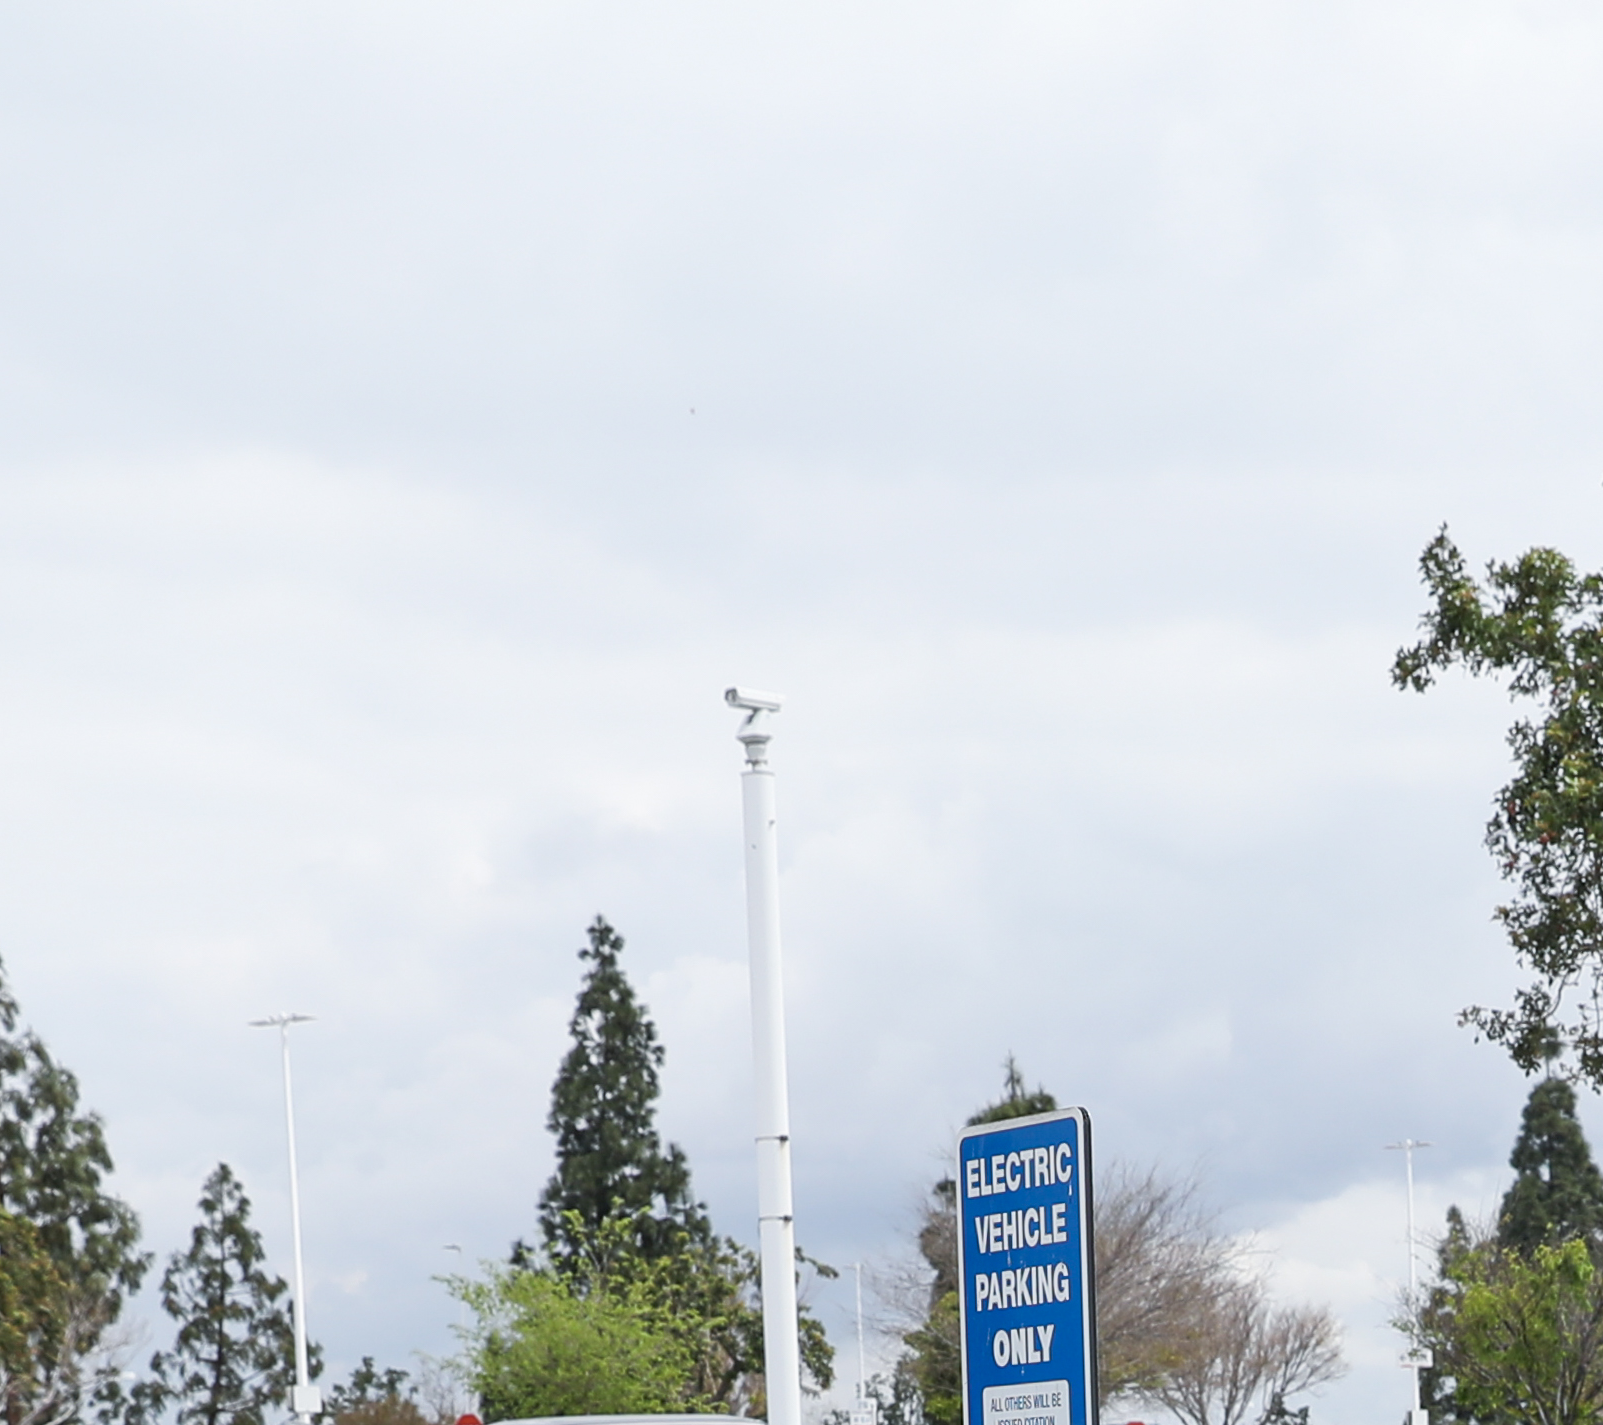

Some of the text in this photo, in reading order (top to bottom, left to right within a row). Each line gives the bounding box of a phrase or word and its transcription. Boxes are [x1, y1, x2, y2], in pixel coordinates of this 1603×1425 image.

[967, 1143, 1072, 1198] ELECTRIC
[975, 1203, 1068, 1253] VEHICLE
[976, 1262, 1070, 1311] PARKING
[994, 1324, 1055, 1367] ONLY
[991, 1391, 1062, 1413] ALL OTHERS WILL BE
